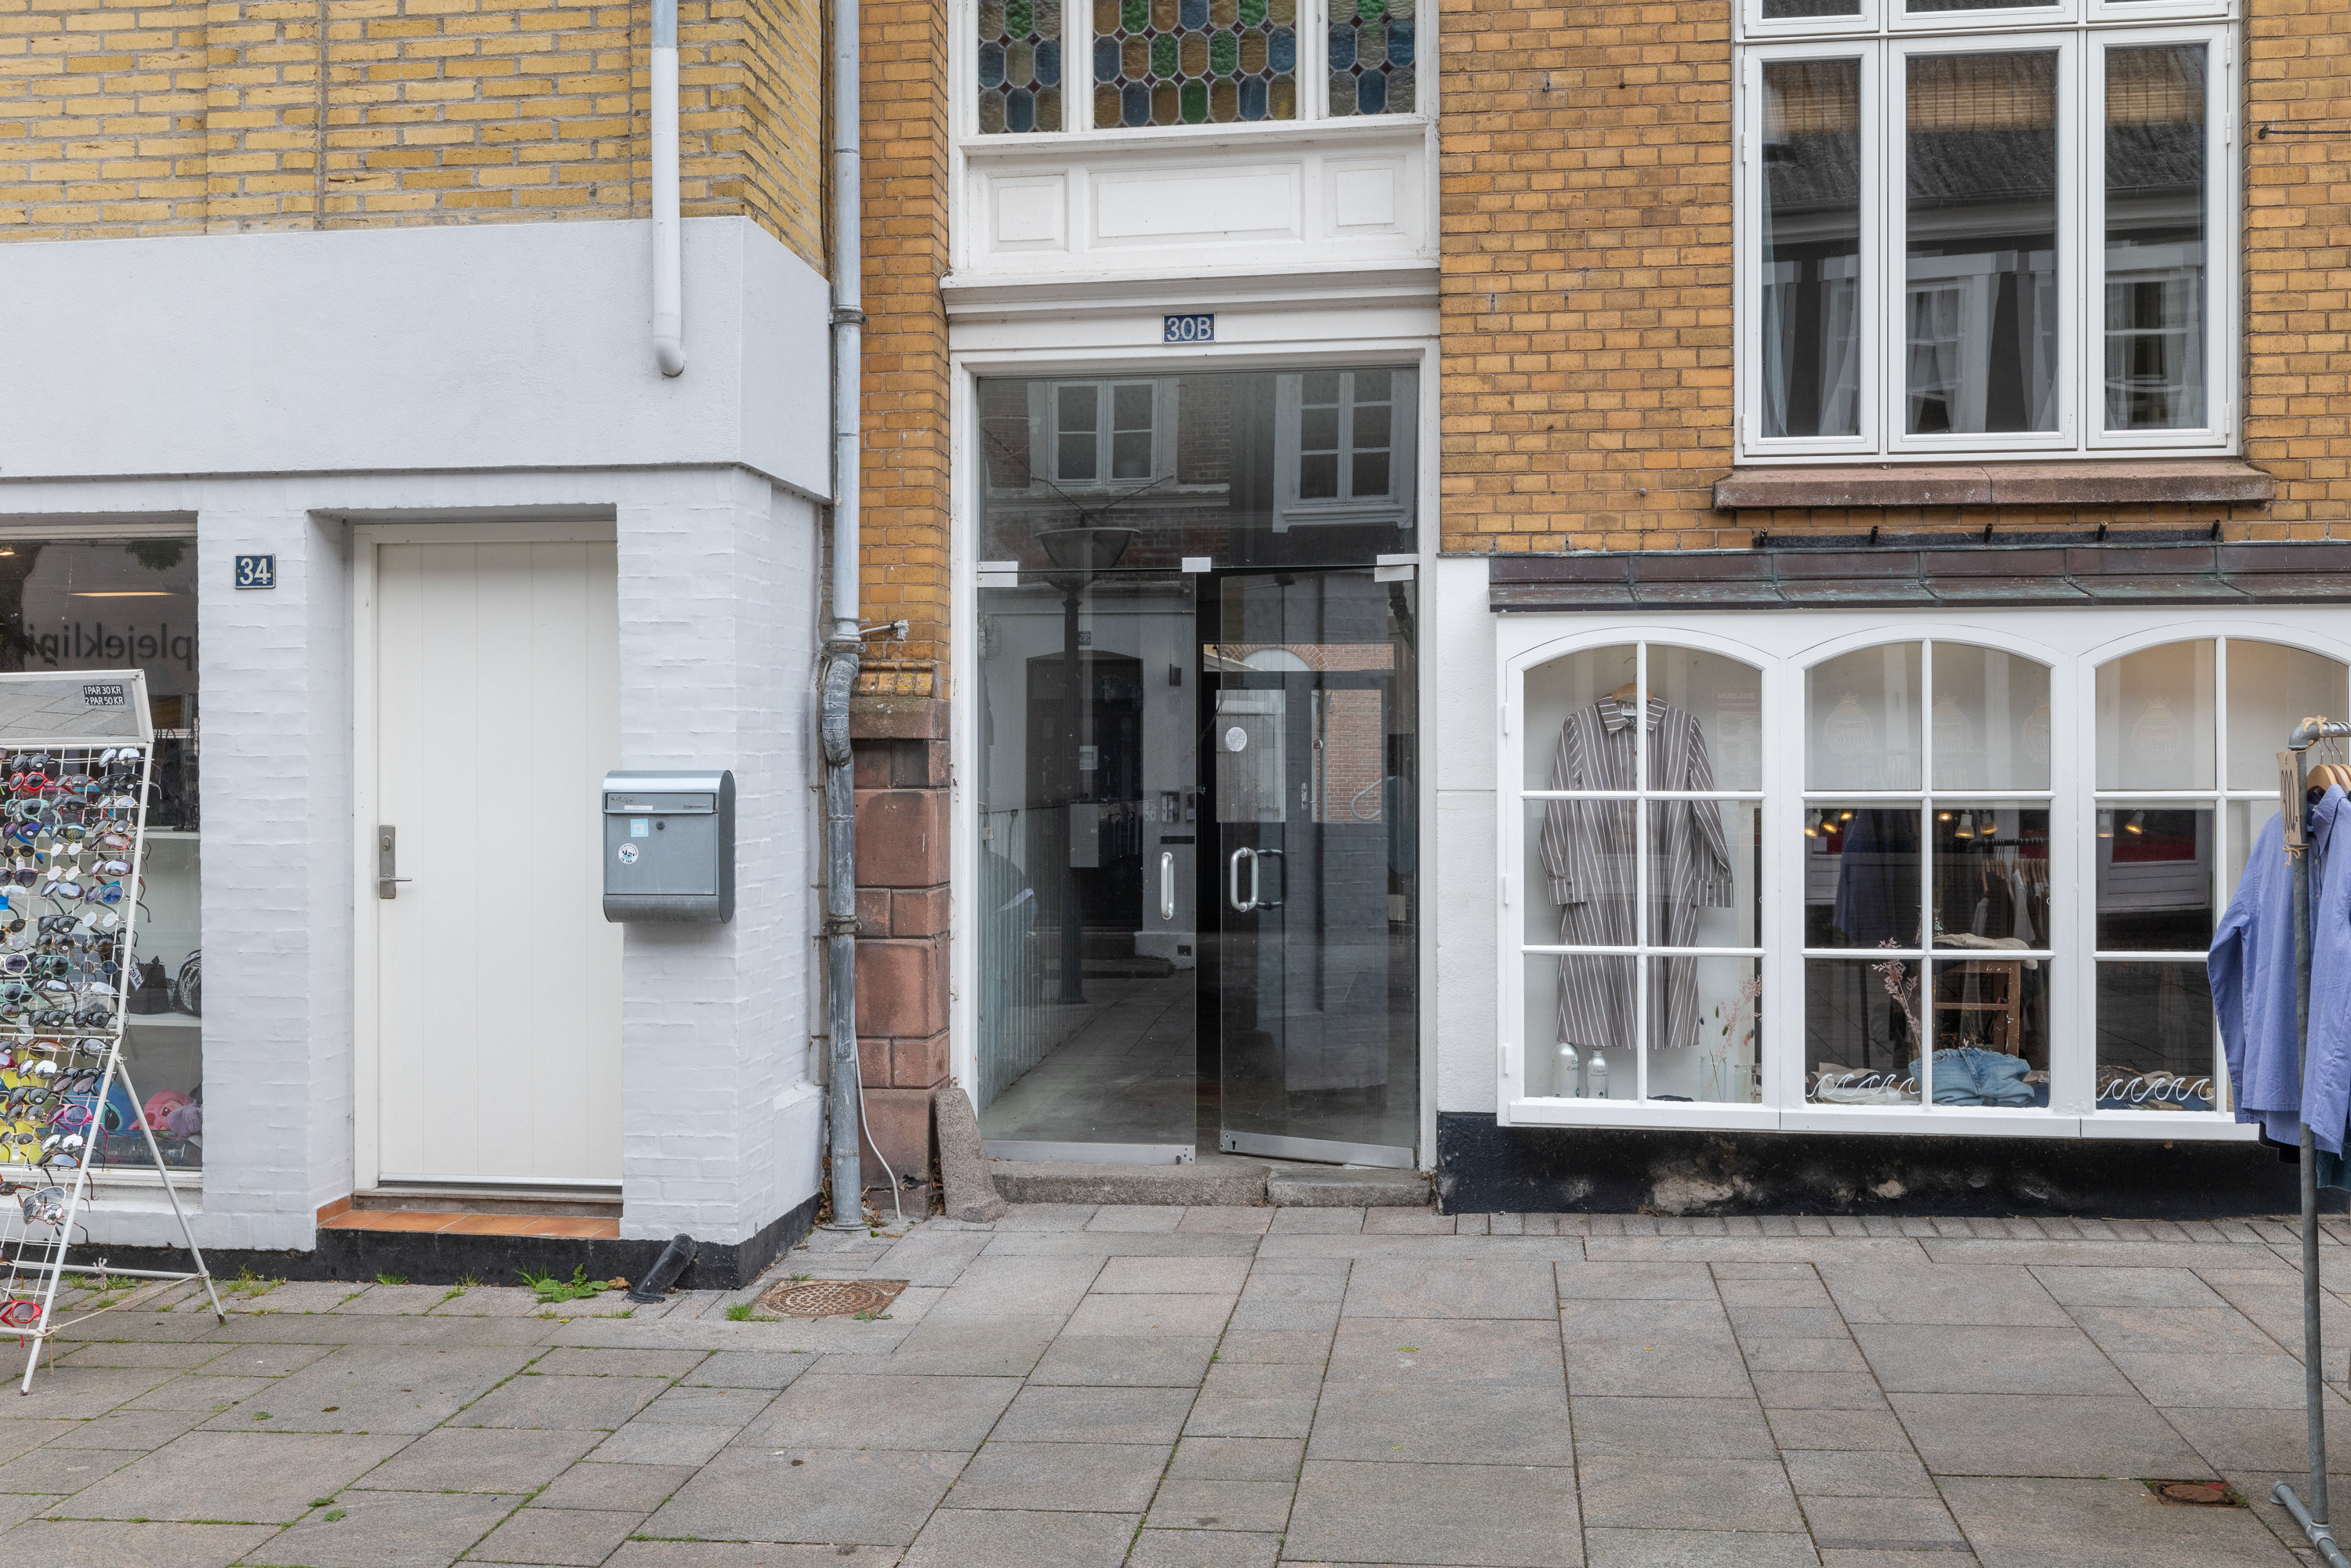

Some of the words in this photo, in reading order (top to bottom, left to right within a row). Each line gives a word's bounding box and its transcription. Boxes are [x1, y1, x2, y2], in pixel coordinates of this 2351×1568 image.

[1167, 317, 1212, 341] 30B
[240, 557, 271, 585] 34
[111, 686, 121, 694] KR
[85, 697, 89, 705] 2
